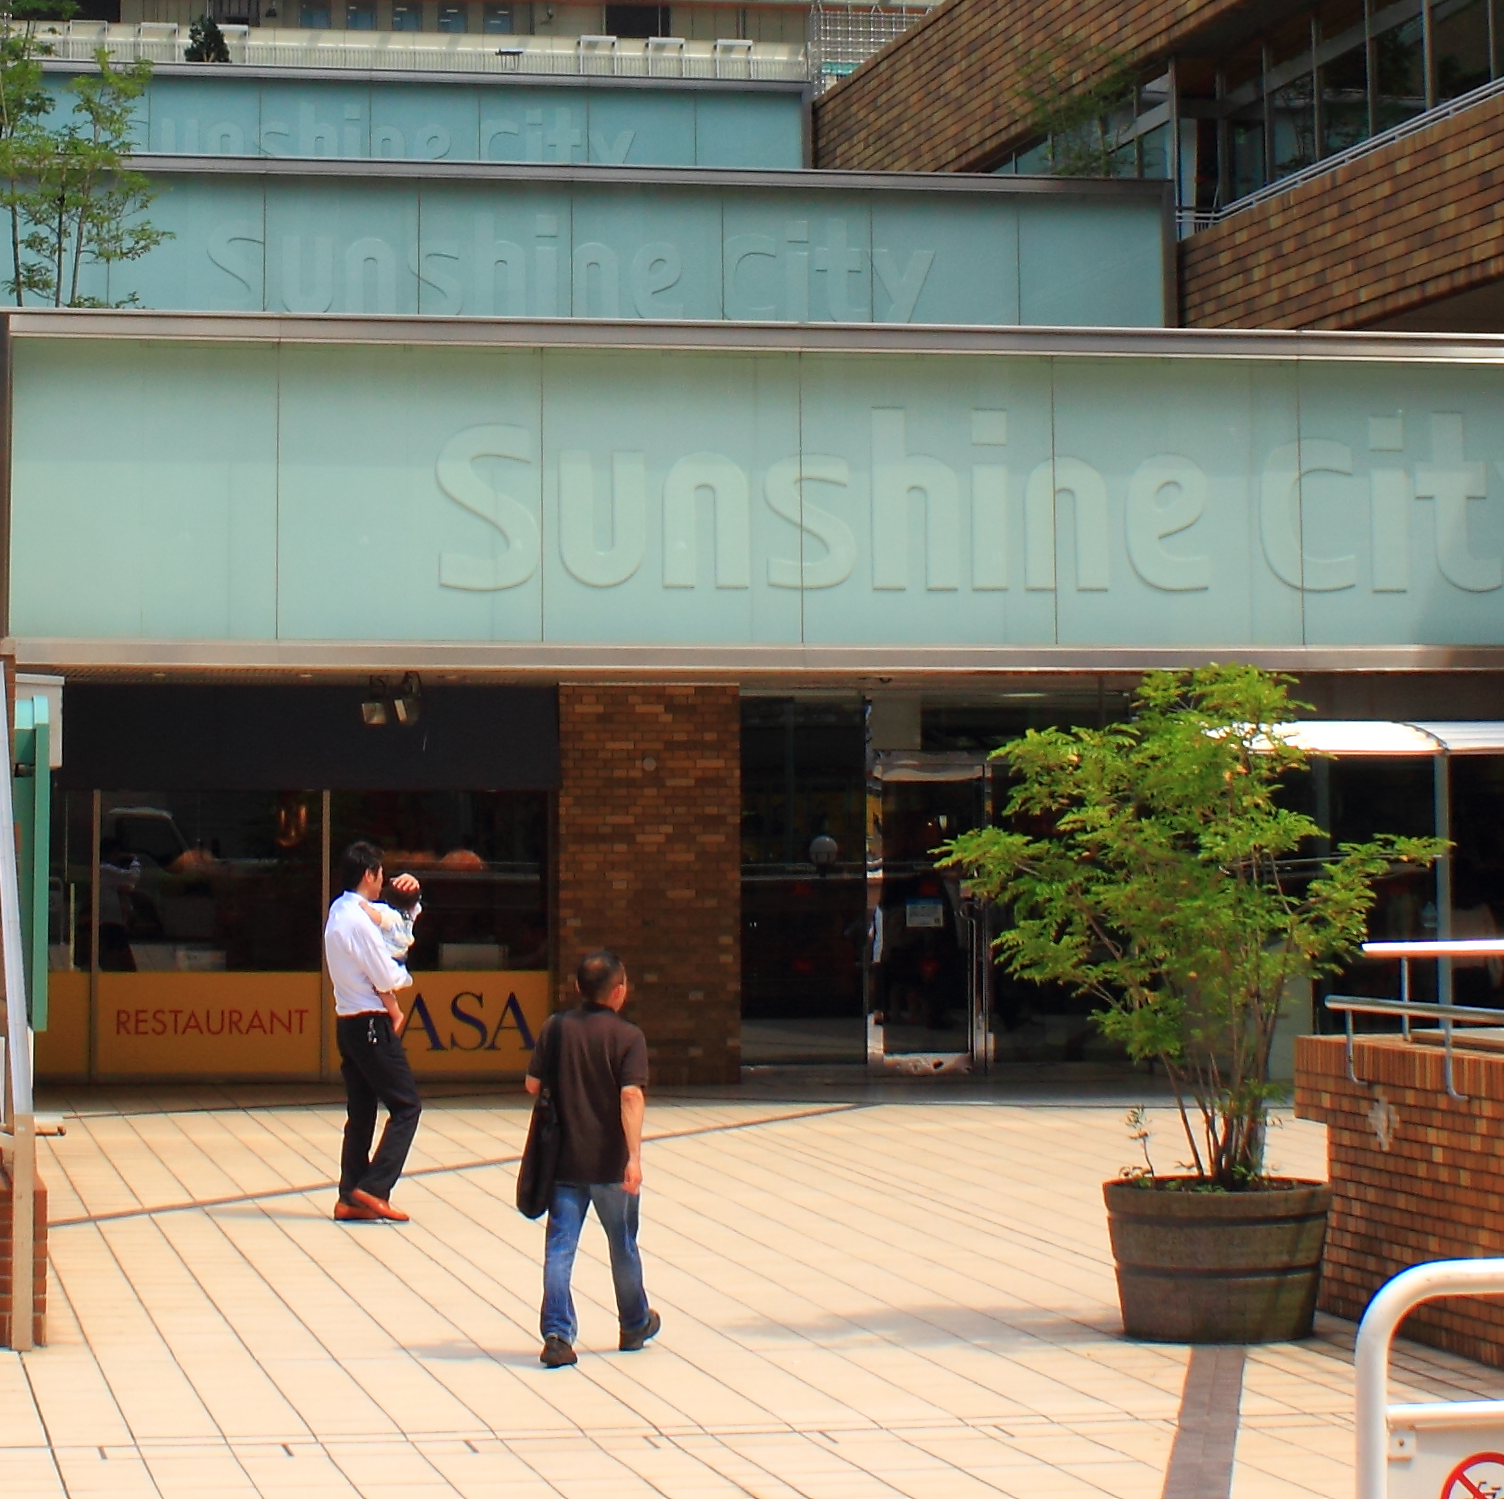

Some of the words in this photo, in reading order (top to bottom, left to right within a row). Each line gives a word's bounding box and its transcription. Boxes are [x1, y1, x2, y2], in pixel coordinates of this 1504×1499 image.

[137, 102, 452, 160] unshine
[206, 214, 684, 318] Sunshine
[723, 219, 935, 323] City
[434, 405, 1211, 594] Sunshine
[116, 1009, 309, 1036] RESTAURANT
[401, 991, 535, 1051] ASA
